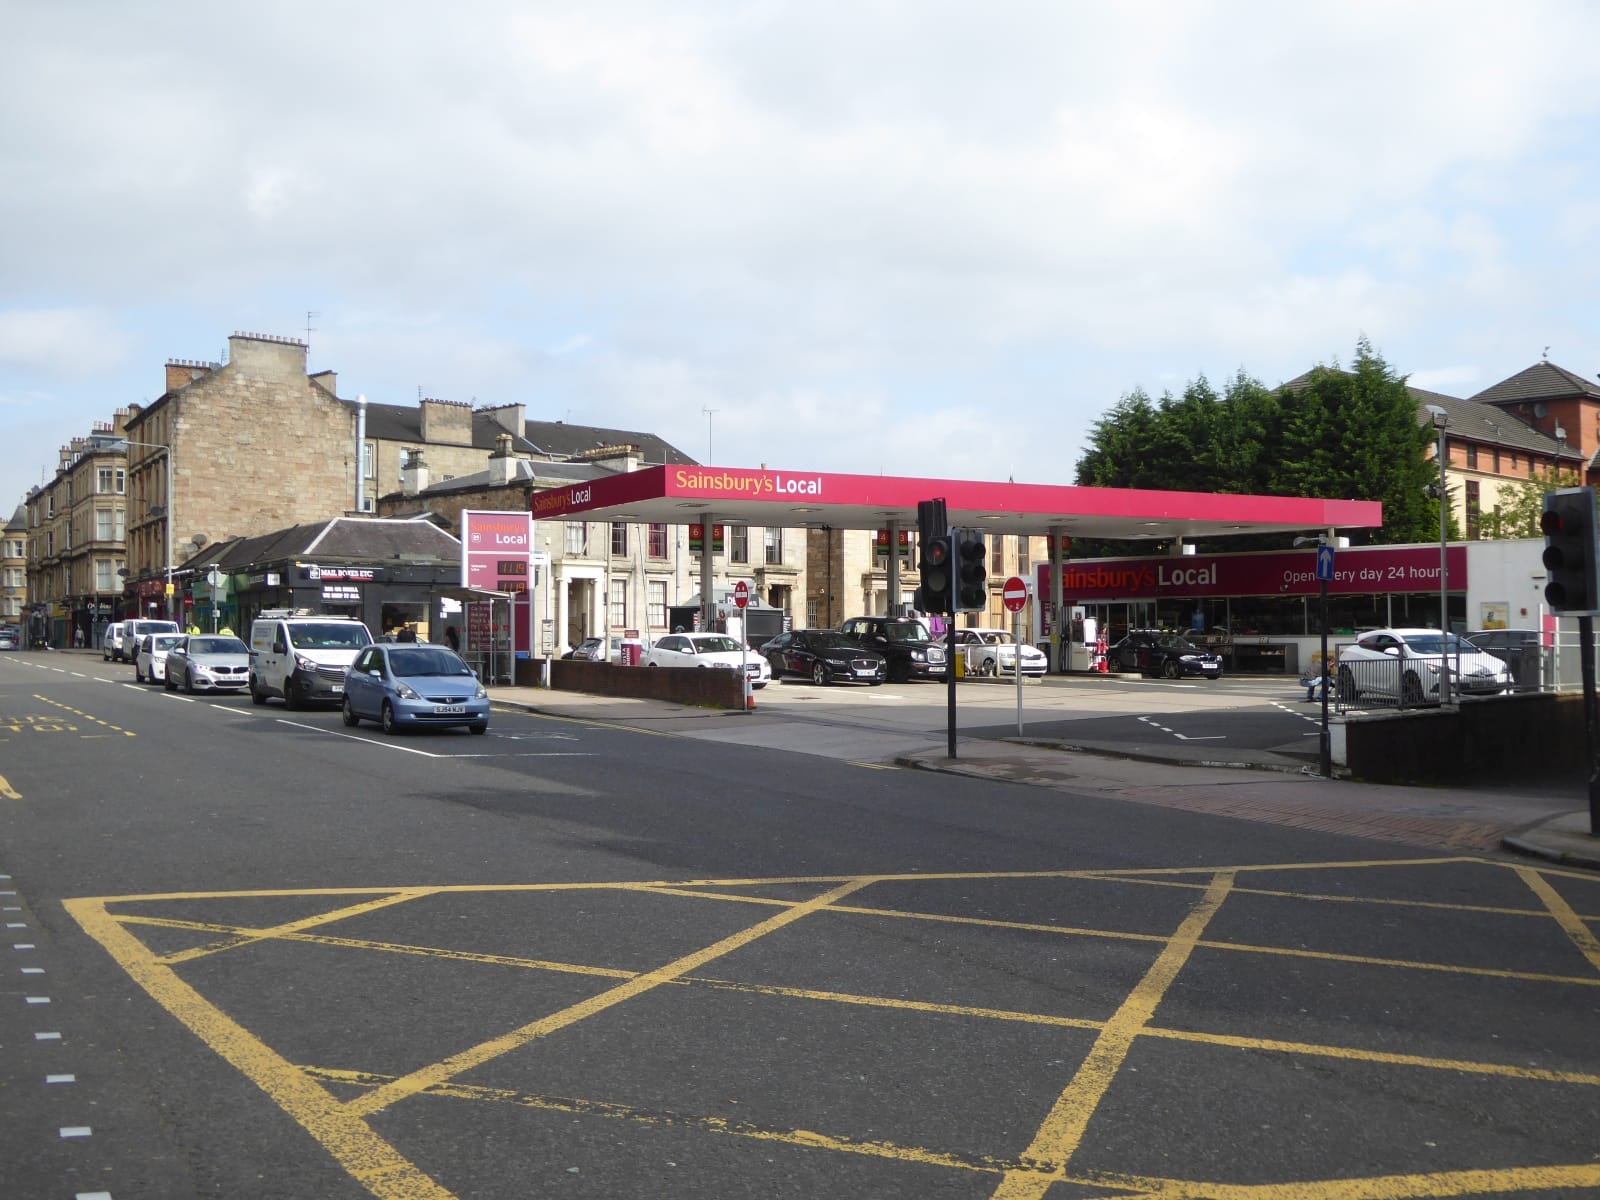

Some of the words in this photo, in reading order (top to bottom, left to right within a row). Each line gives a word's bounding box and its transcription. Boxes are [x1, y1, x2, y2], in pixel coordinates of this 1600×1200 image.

[676, 471, 773, 495] Sainsbury's
[776, 475, 822, 495] Local
[534, 493, 571, 513] Sainsbury's
[571, 485, 591, 505] Local
[496, 533, 527, 544] Local
[693, 528, 699, 536] 6
[714, 528, 720, 536] 5
[880, 533, 886, 541] 4
[1048, 567, 1155, 592] ainsbury's
[1158, 563, 1217, 586] Local
[1283, 570, 1315, 584] Open
[1360, 567, 1384, 582] day
[1387, 566, 1405, 580] 24
